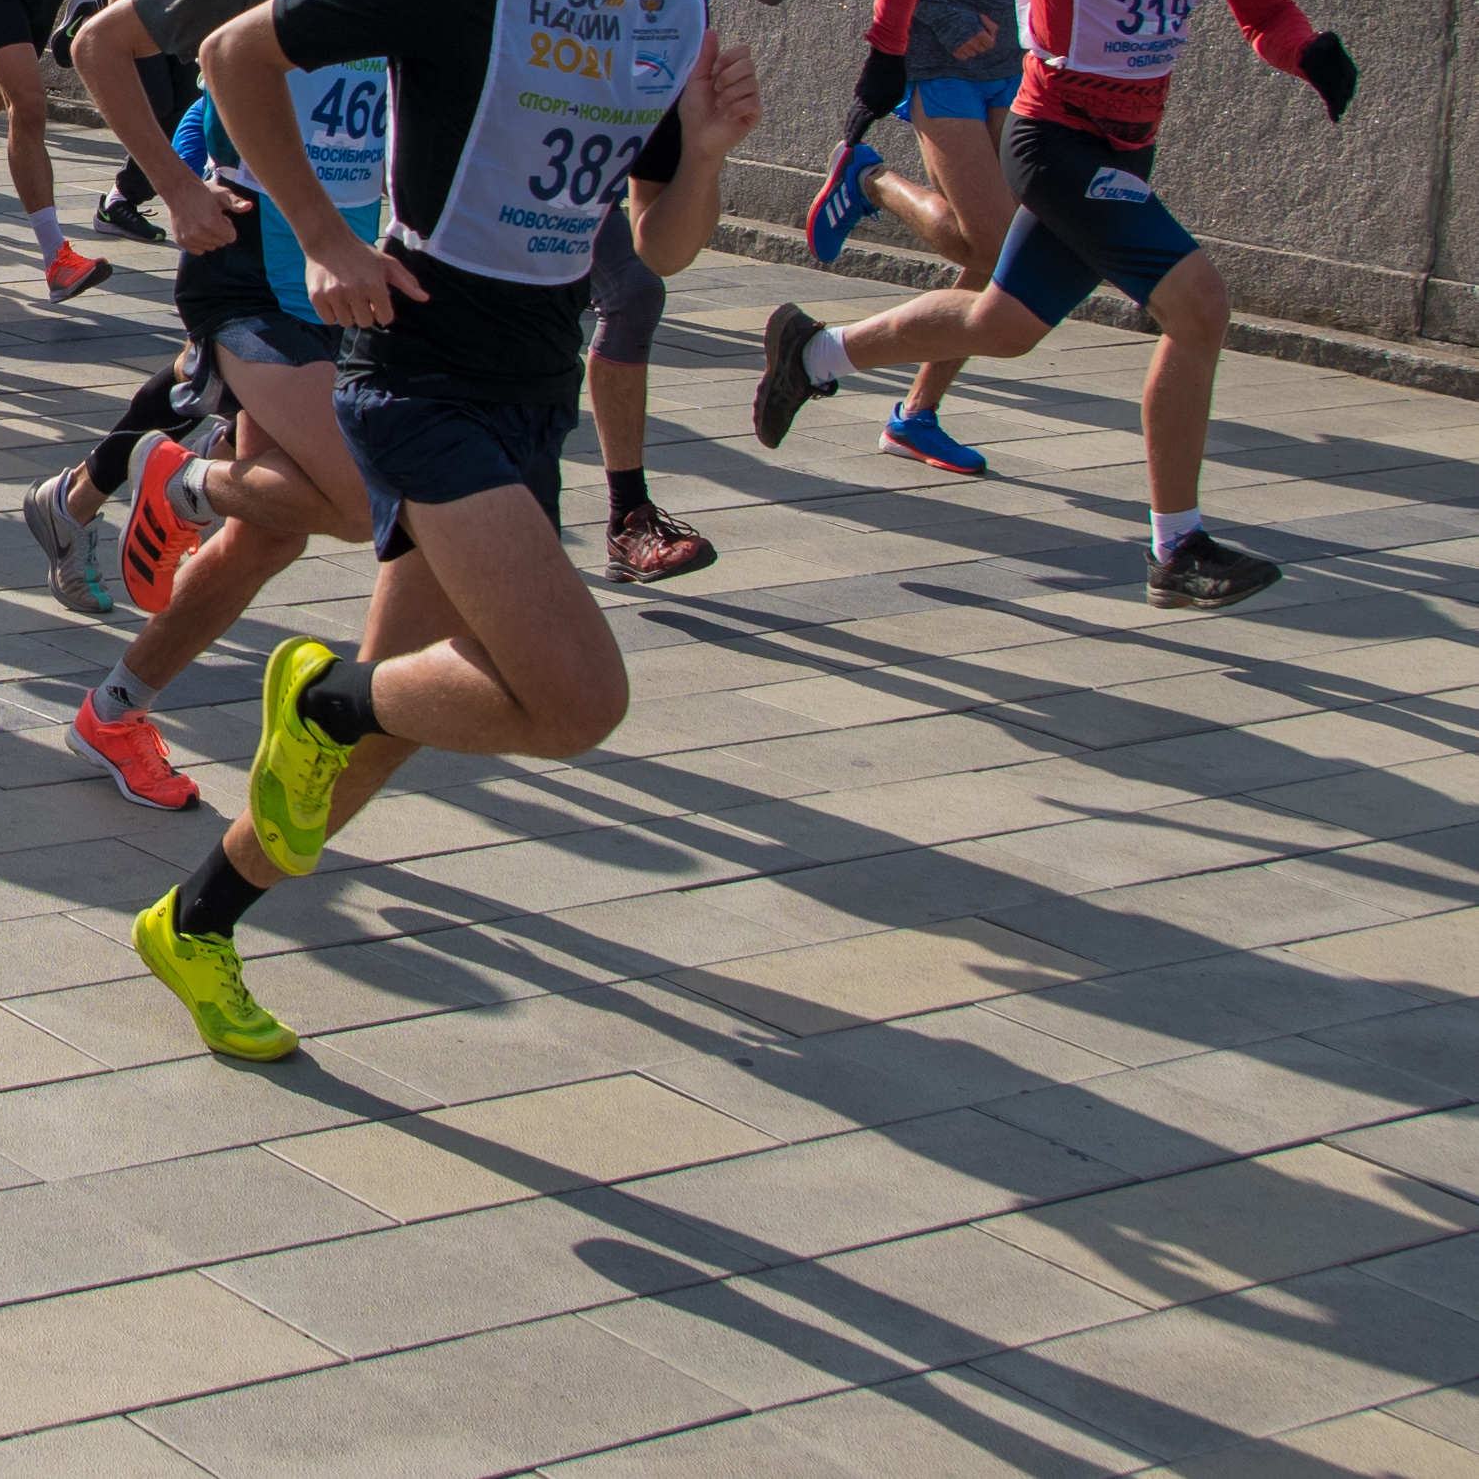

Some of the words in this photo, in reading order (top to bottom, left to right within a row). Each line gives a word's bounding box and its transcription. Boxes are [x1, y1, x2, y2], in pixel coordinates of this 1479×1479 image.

[529, 0, 621, 42] НАЦИИ
[528, 31, 614, 82] 2021
[518, 91, 570, 116] СПОРТ
[578, 106, 635, 125] НОРМА
[315, 165, 371, 181] ОБЛАСТЬ
[528, 127, 643, 206] 382
[527, 235, 591, 255] ОБЛАСТЬ
